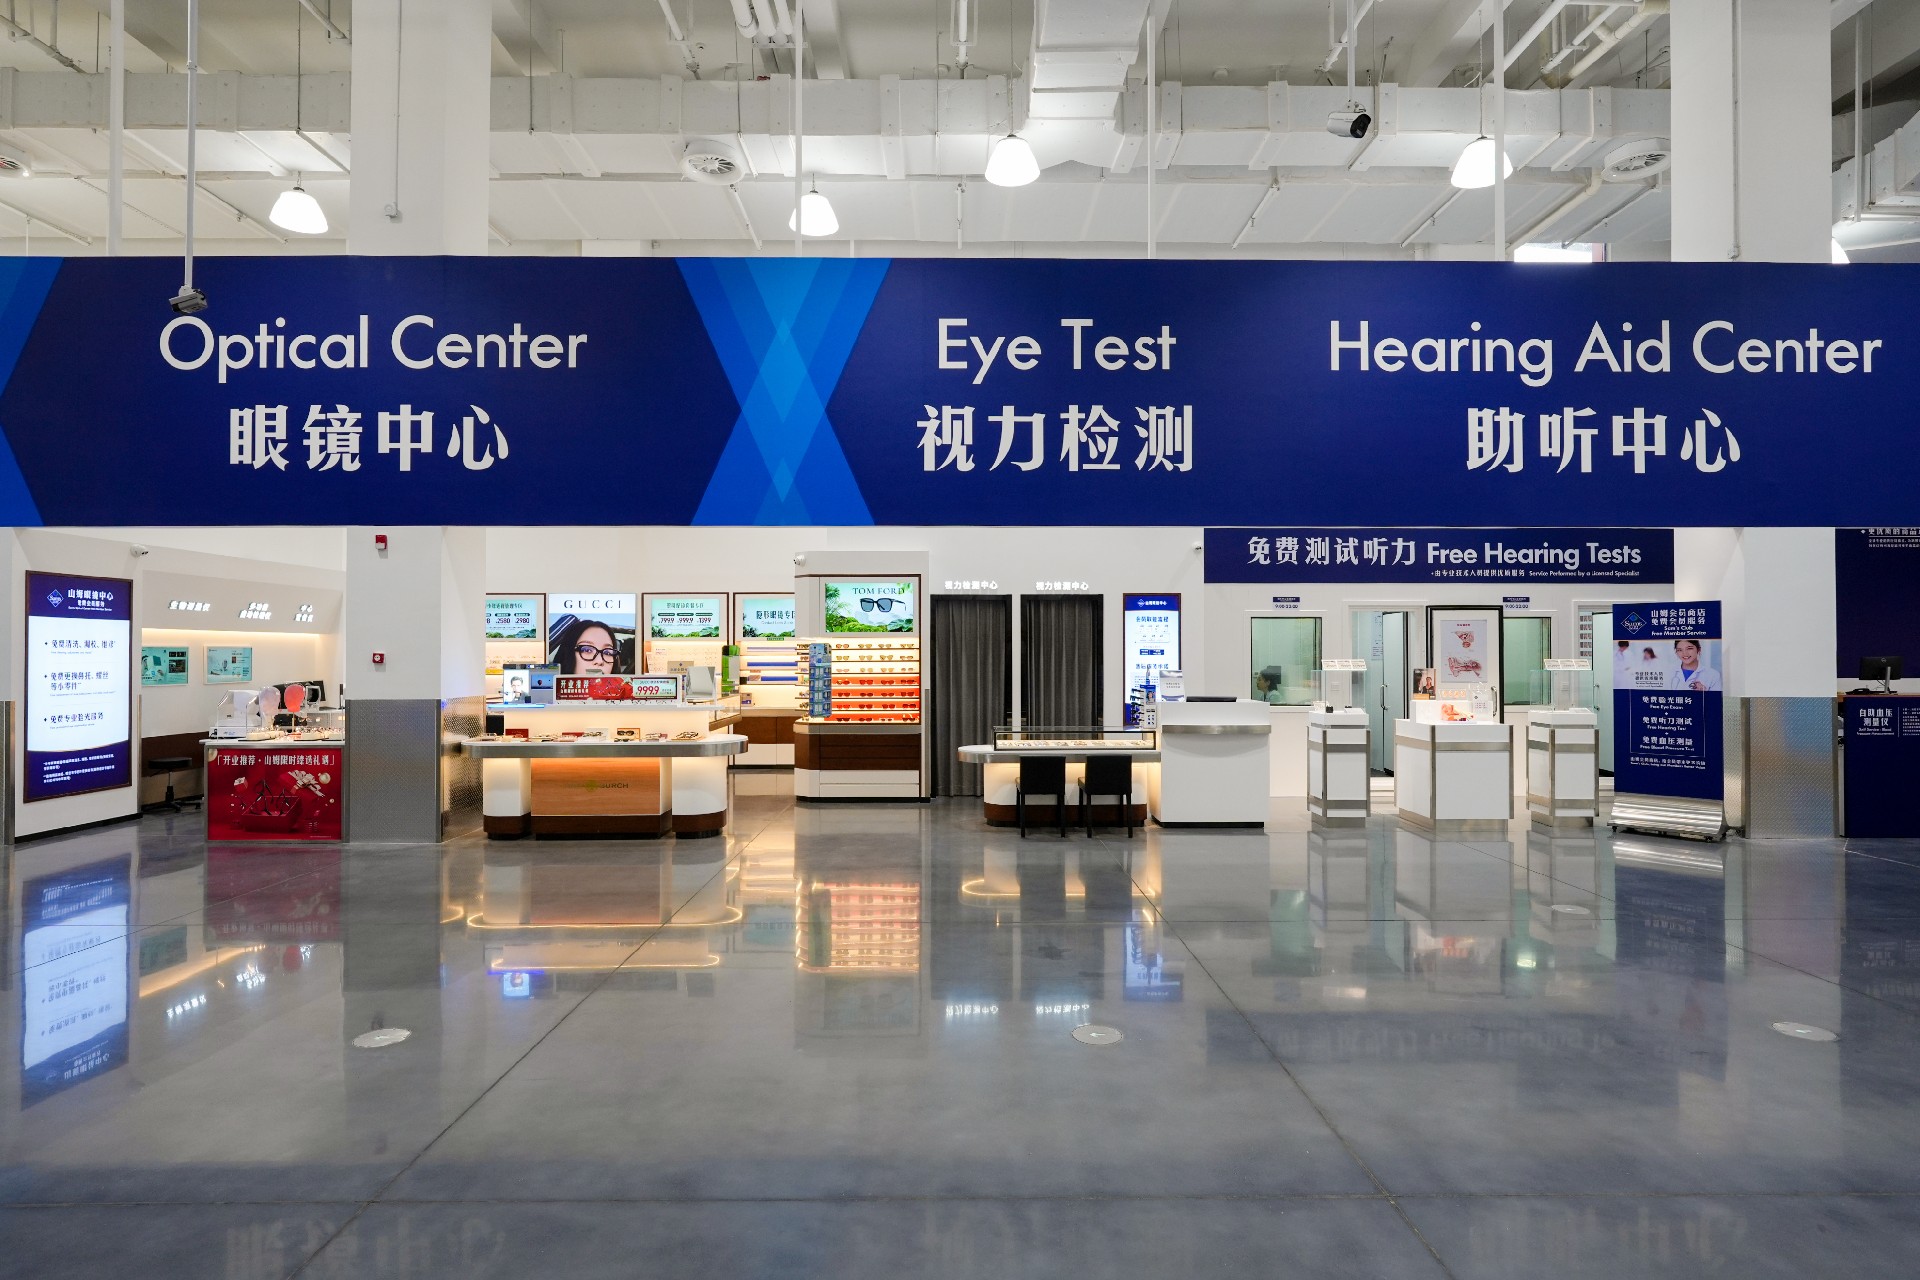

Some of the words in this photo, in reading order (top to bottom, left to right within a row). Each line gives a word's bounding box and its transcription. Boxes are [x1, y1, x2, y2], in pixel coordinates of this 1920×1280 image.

[159, 314, 368, 383] Optical
[391, 314, 588, 369] Center
[938, 318, 1042, 384] Eye
[1060, 318, 1177, 370] Test
[1330, 320, 1553, 387] Hearing
[1574, 320, 1671, 373] Aid
[1693, 320, 1882, 373] Center
[229, 404, 509, 471] 眼镜中心
[916, 404, 1193, 472] 视力检测
[1467, 406, 1741, 473] 助听中心
[1247, 536, 1416, 566] 免费测试听力
[1427, 542, 1478, 564] Free
[1484, 541, 1580, 570] Hearing
[1586, 542, 1642, 564] Tests
[564, 600, 621, 608] GUCCI
[1651, 608, 1706, 618] 山姆会员商店
[1642, 716, 1692, 726] 免费听力测试
[1859, 708, 1893, 717] 自助血压
[1864, 717, 1889, 726] 测量仪
[1642, 736, 1693, 746] 免费血压测量
